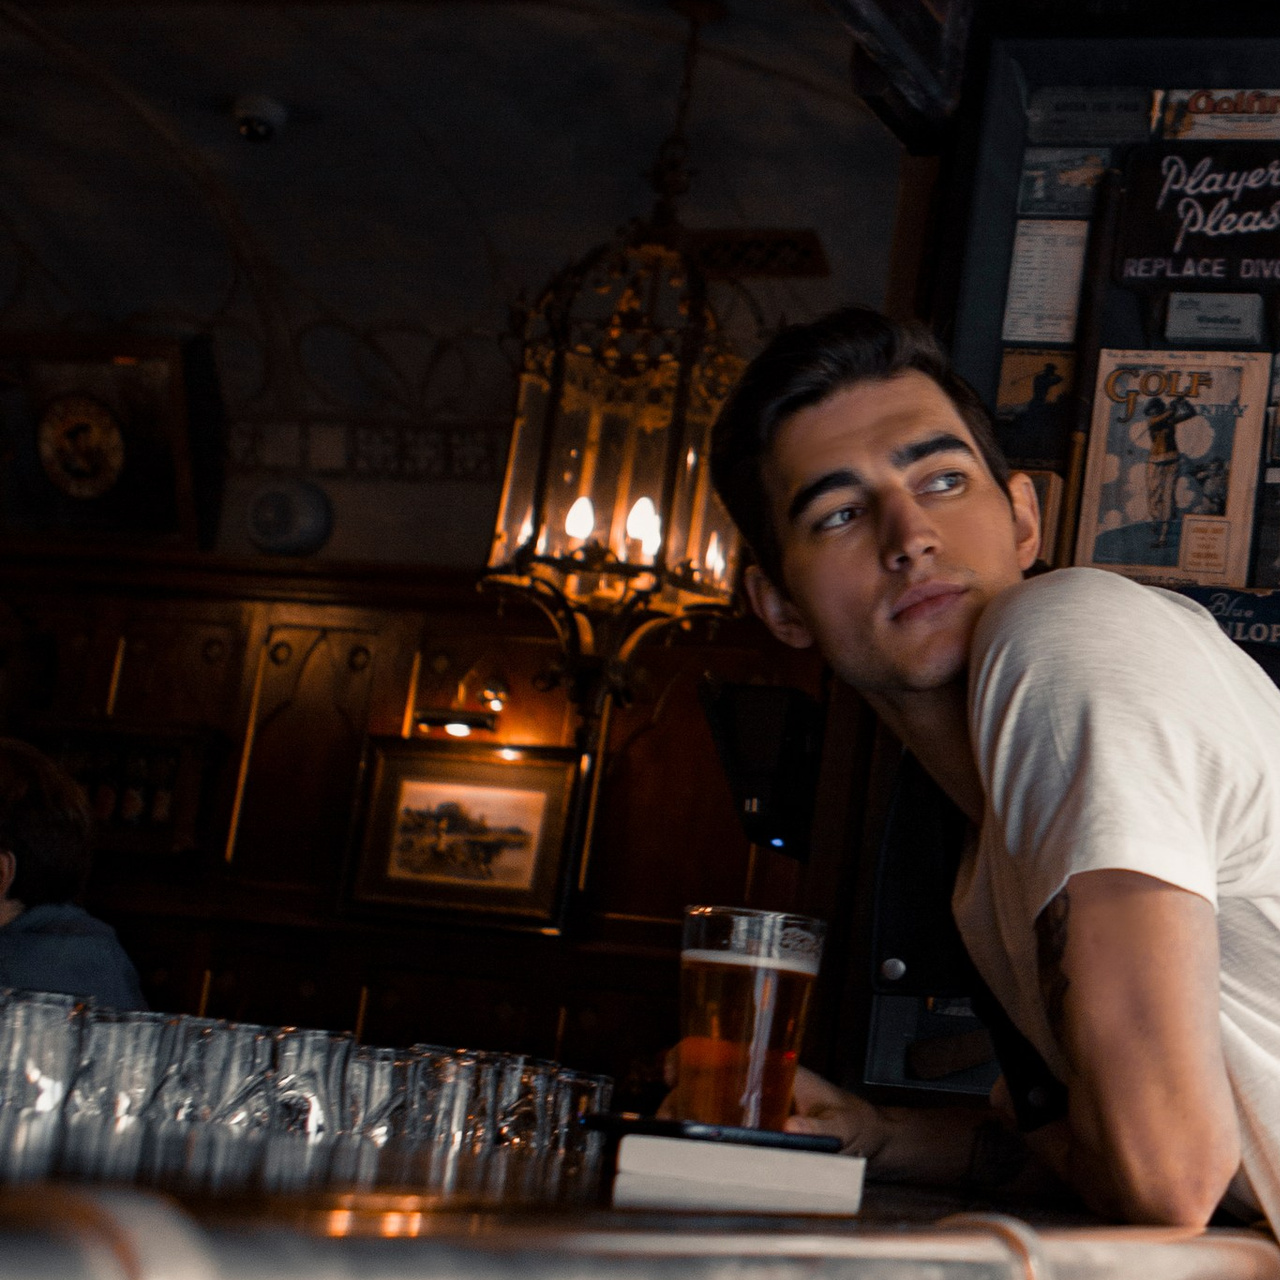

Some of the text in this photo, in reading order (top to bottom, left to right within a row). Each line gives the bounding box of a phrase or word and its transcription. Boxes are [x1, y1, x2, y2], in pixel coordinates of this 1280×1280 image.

[1123, 258, 1227, 278] REPLACE
[1105, 369, 1213, 423] GOLF
[1209, 592, 1255, 618] Blue
